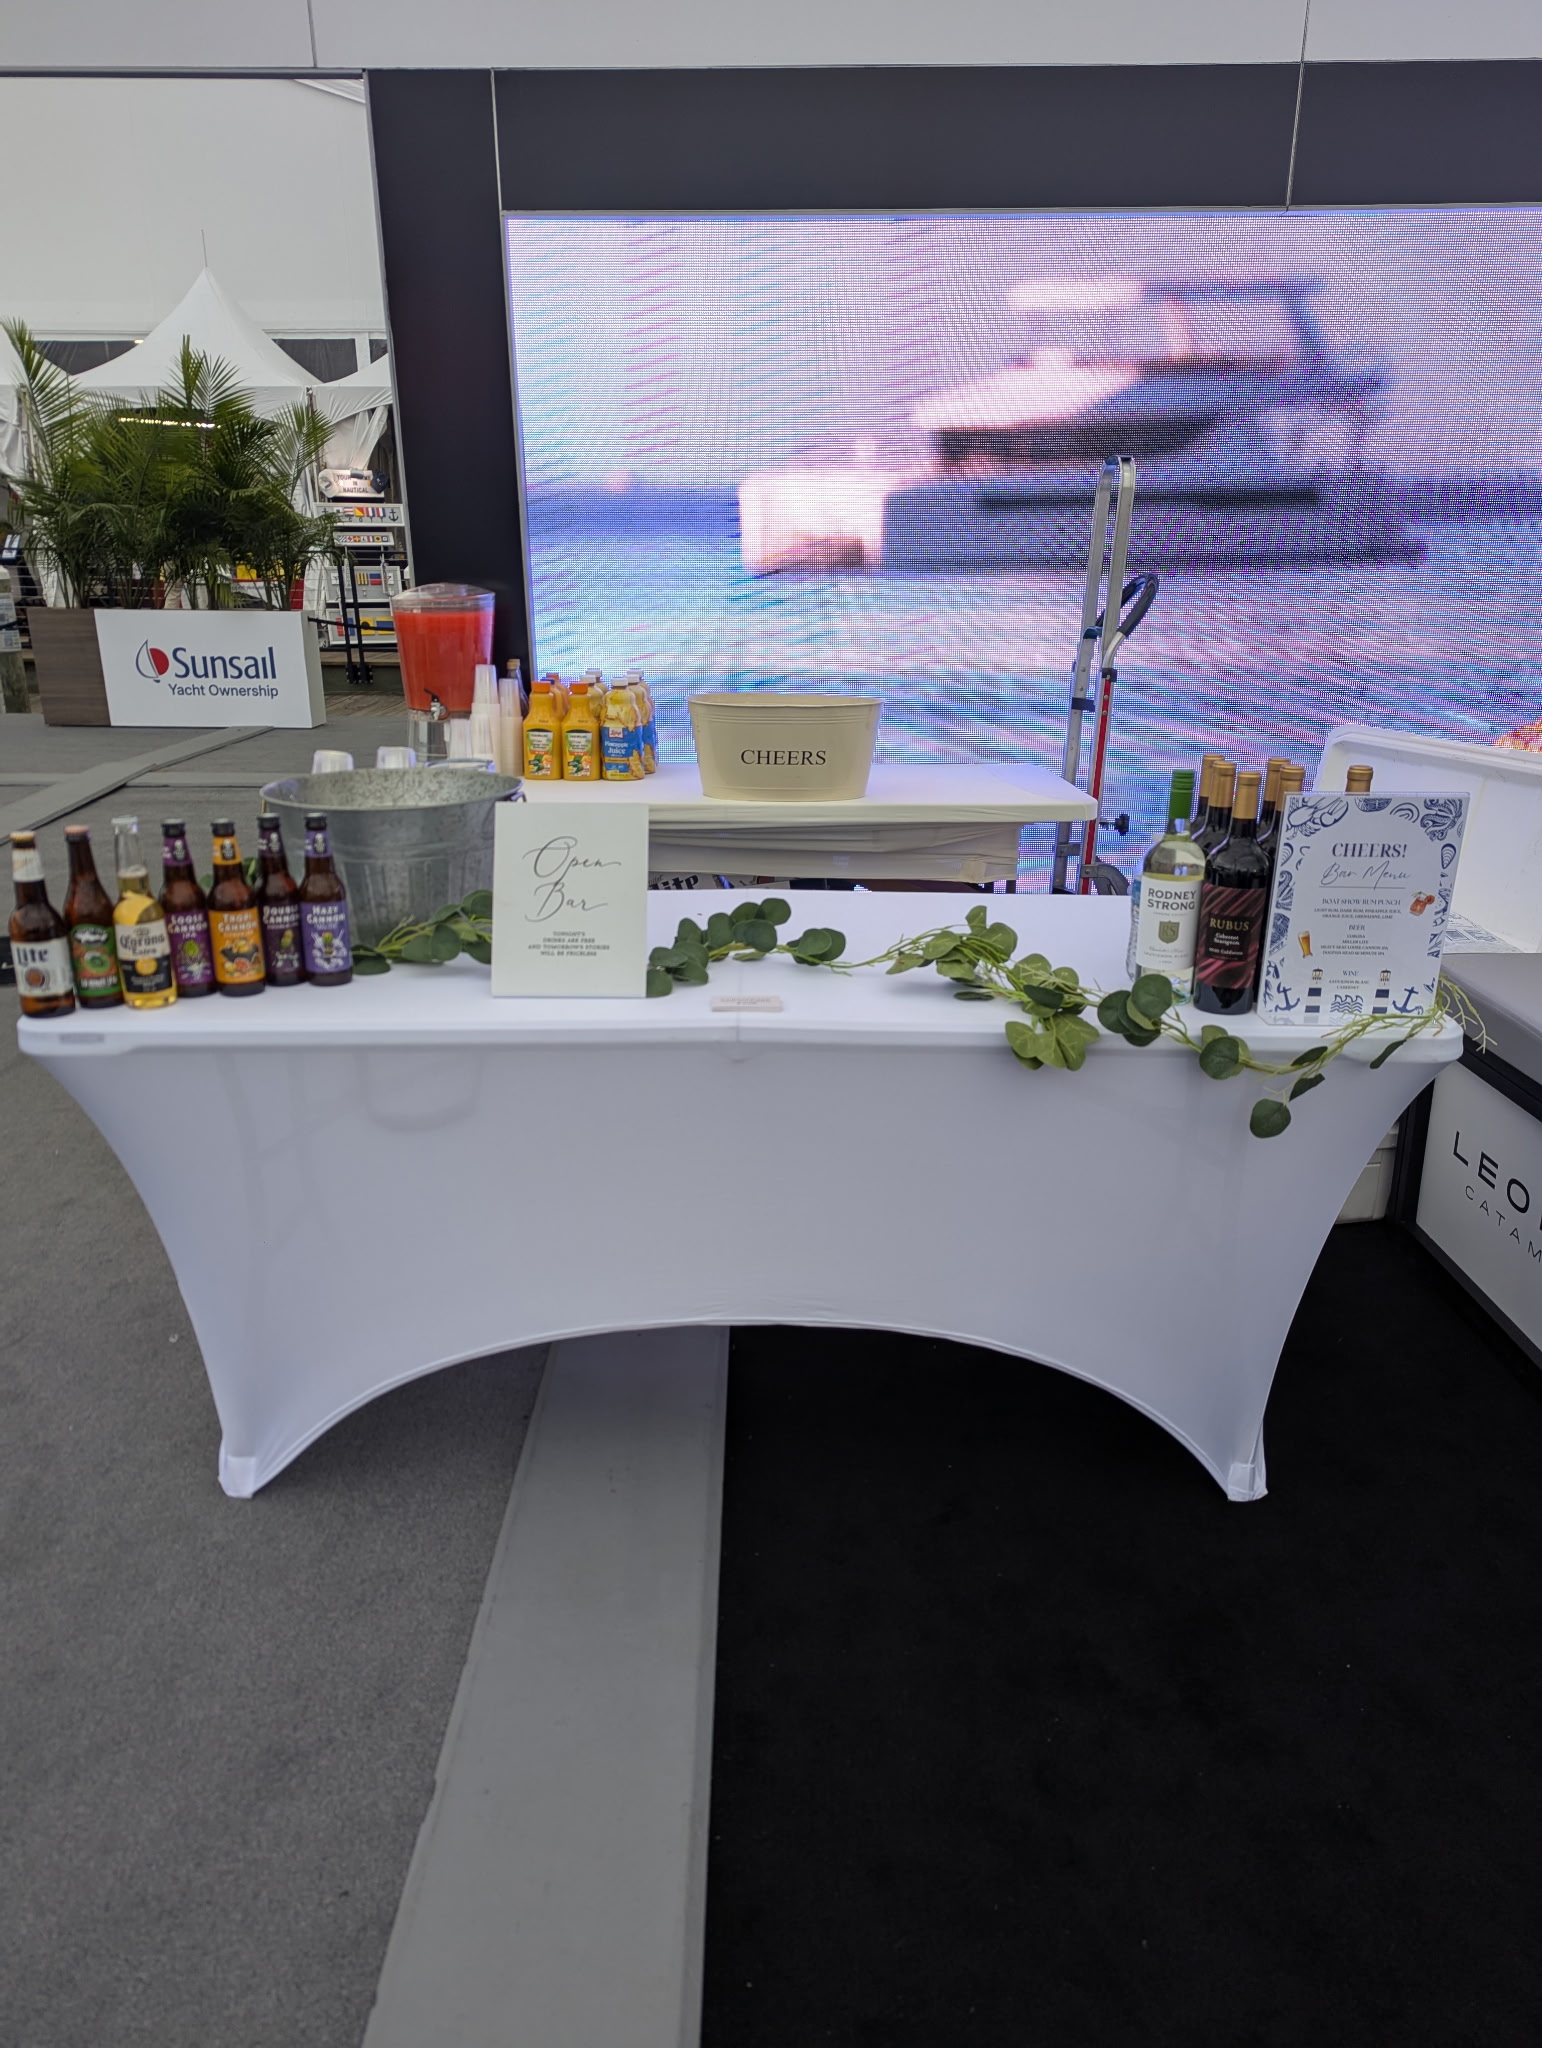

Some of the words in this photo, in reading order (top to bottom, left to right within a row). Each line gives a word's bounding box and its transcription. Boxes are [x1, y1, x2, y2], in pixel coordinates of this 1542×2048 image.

[172, 646, 277, 679] Sunsail
[168, 683, 206, 696] Yacht
[208, 684, 279, 699] Ownership
[608, 746, 626, 755] Juice
[740, 749, 827, 766] CHEERS
[522, 835, 622, 880] Open
[1331, 842, 1408, 859] CHEERS!
[1320, 861, 1357, 885] Bar
[1362, 860, 1411, 891] Menu
[524, 880, 608, 923] Bar
[1147, 887, 1197, 900] RODNEY
[1147, 898, 1195, 911] STRONG
[170, 913, 203, 925] LOOSE
[306, 912, 346, 924] CANNON
[1210, 917, 1250, 931] RUBUS
[120, 933, 165, 951] Corona
[1453, 1130, 1542, 1231] LEO
